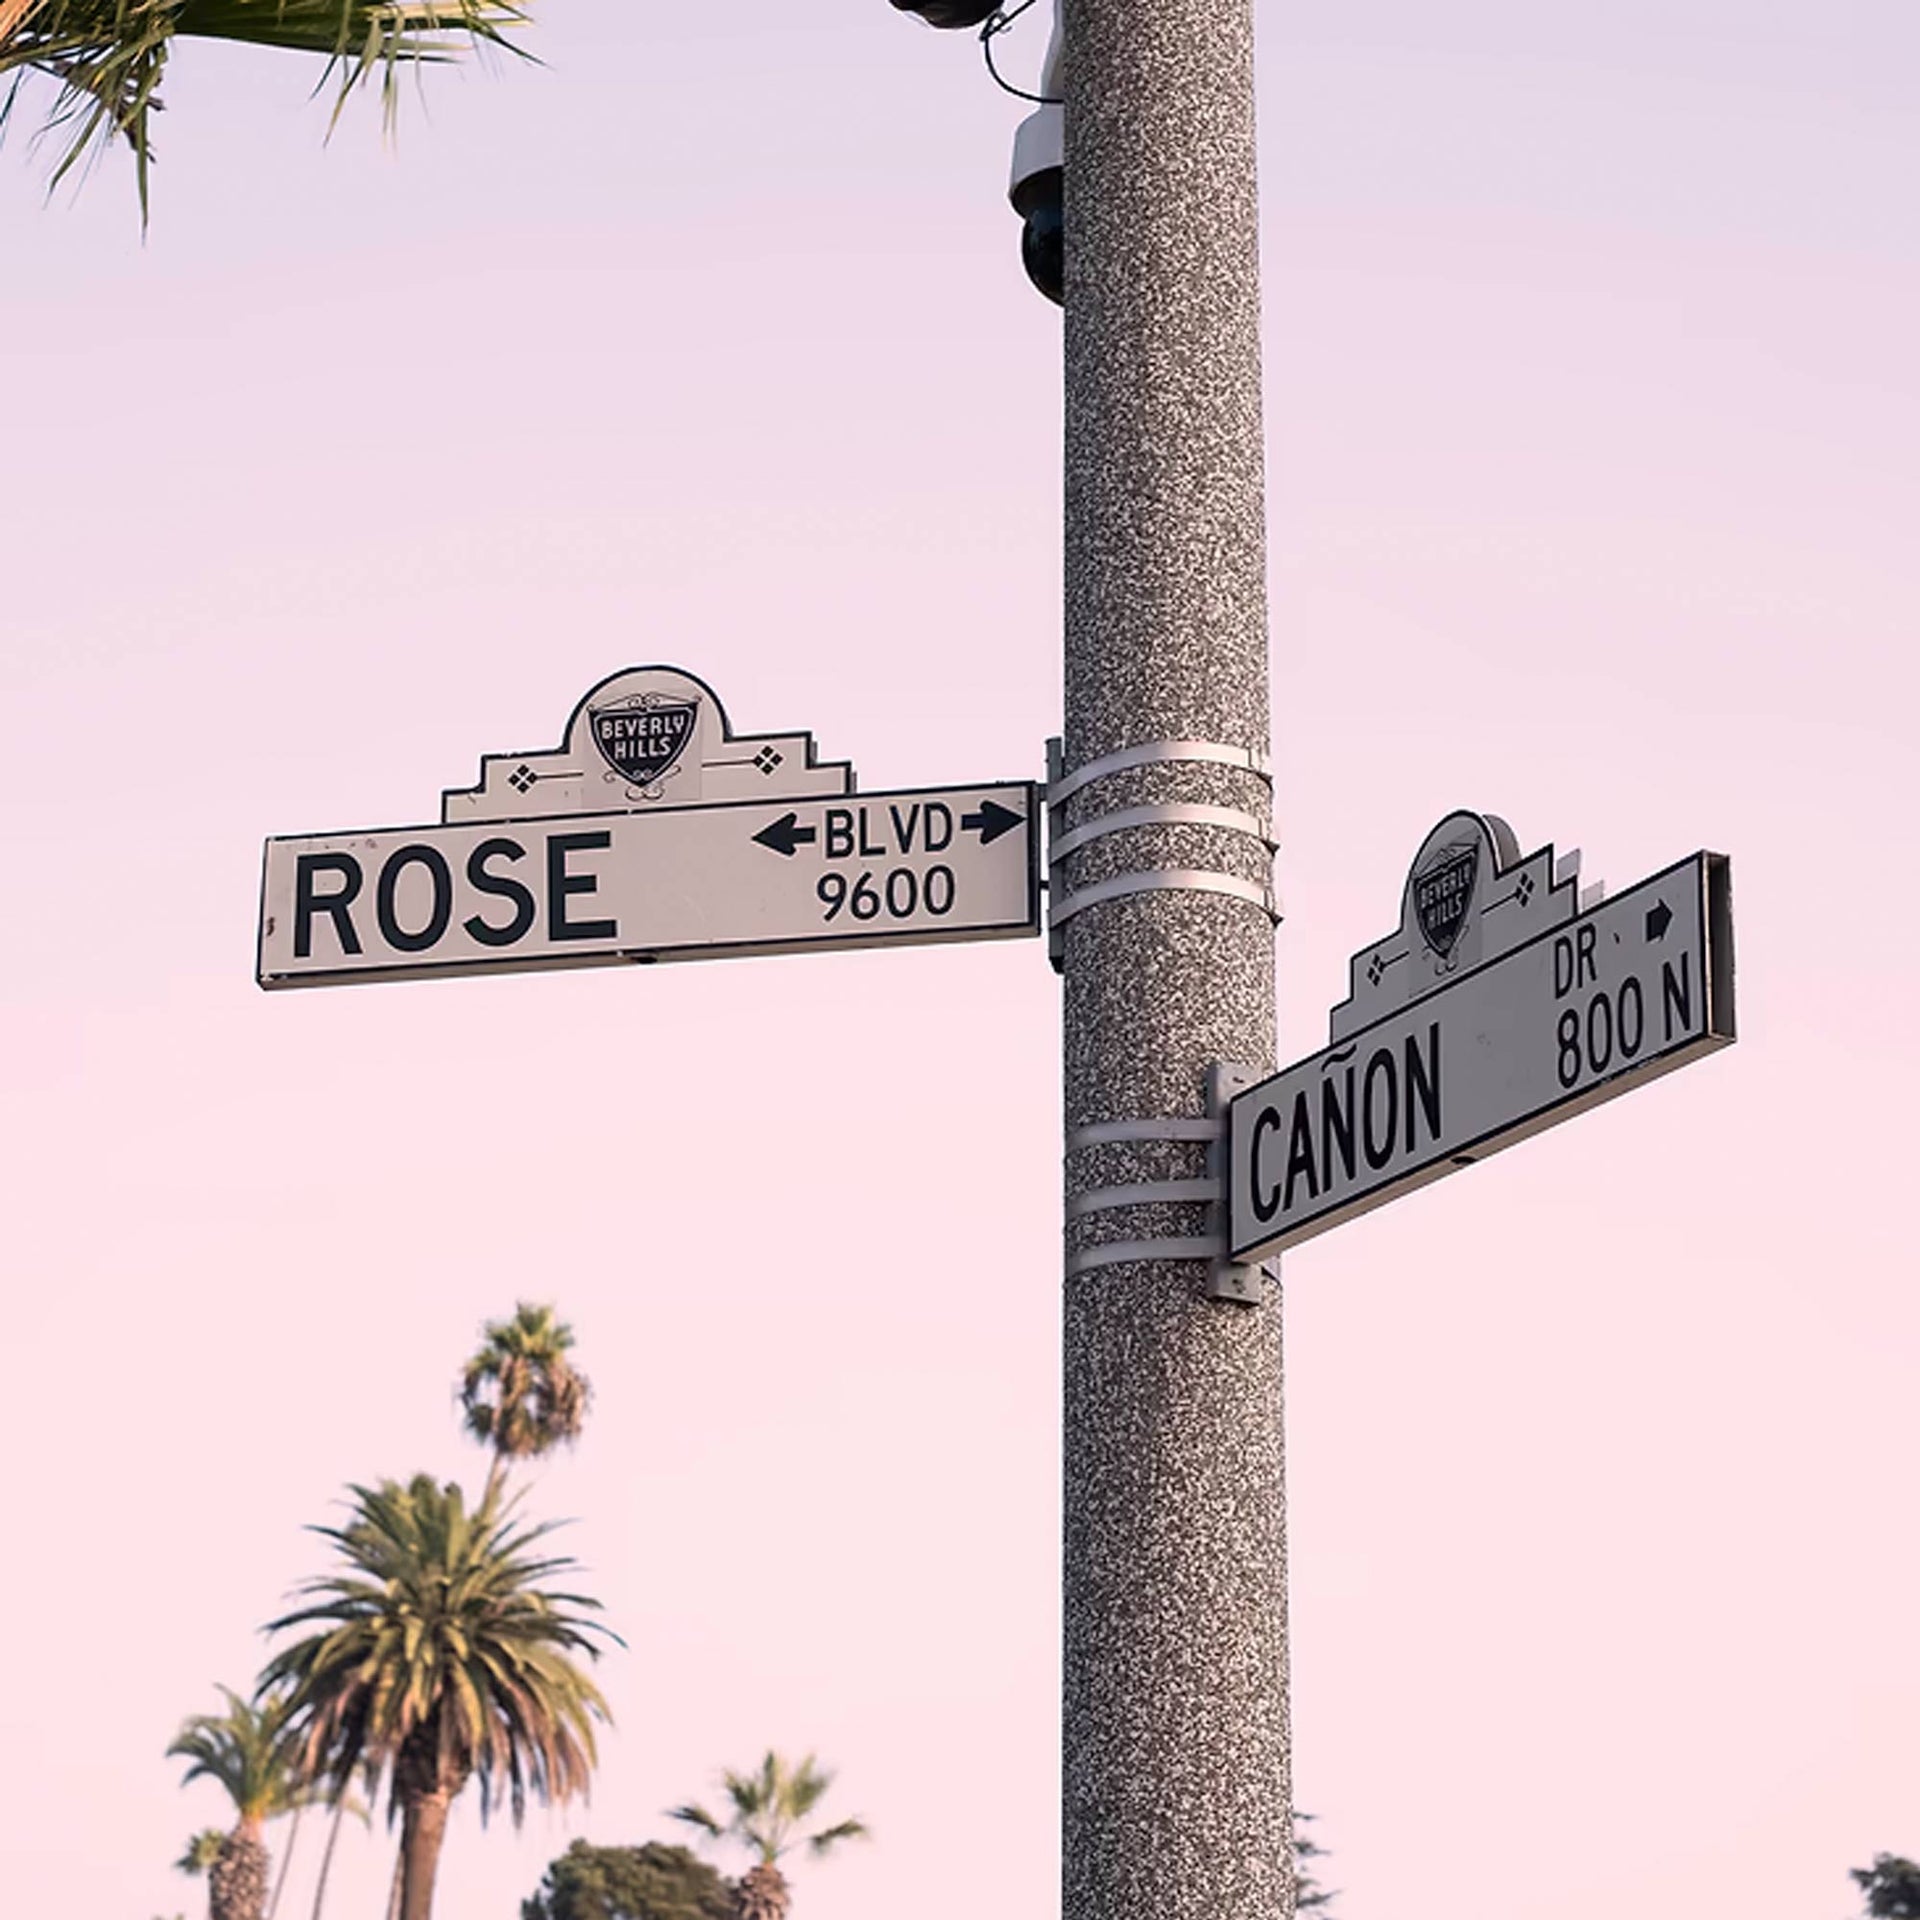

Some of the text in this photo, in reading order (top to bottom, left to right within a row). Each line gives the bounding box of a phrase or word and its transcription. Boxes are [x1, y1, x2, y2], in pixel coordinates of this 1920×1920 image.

[601, 714, 685, 740] BEVERLY
[614, 736, 672, 760] HILLS
[824, 802, 953, 859] BLVD
[293, 829, 618, 959] ROSE
[816, 865, 955, 922] 9600
[1554, 922, 1598, 999] DR
[1557, 951, 1692, 1089] 800 N
[1249, 1021, 1442, 1223] CAÑON
